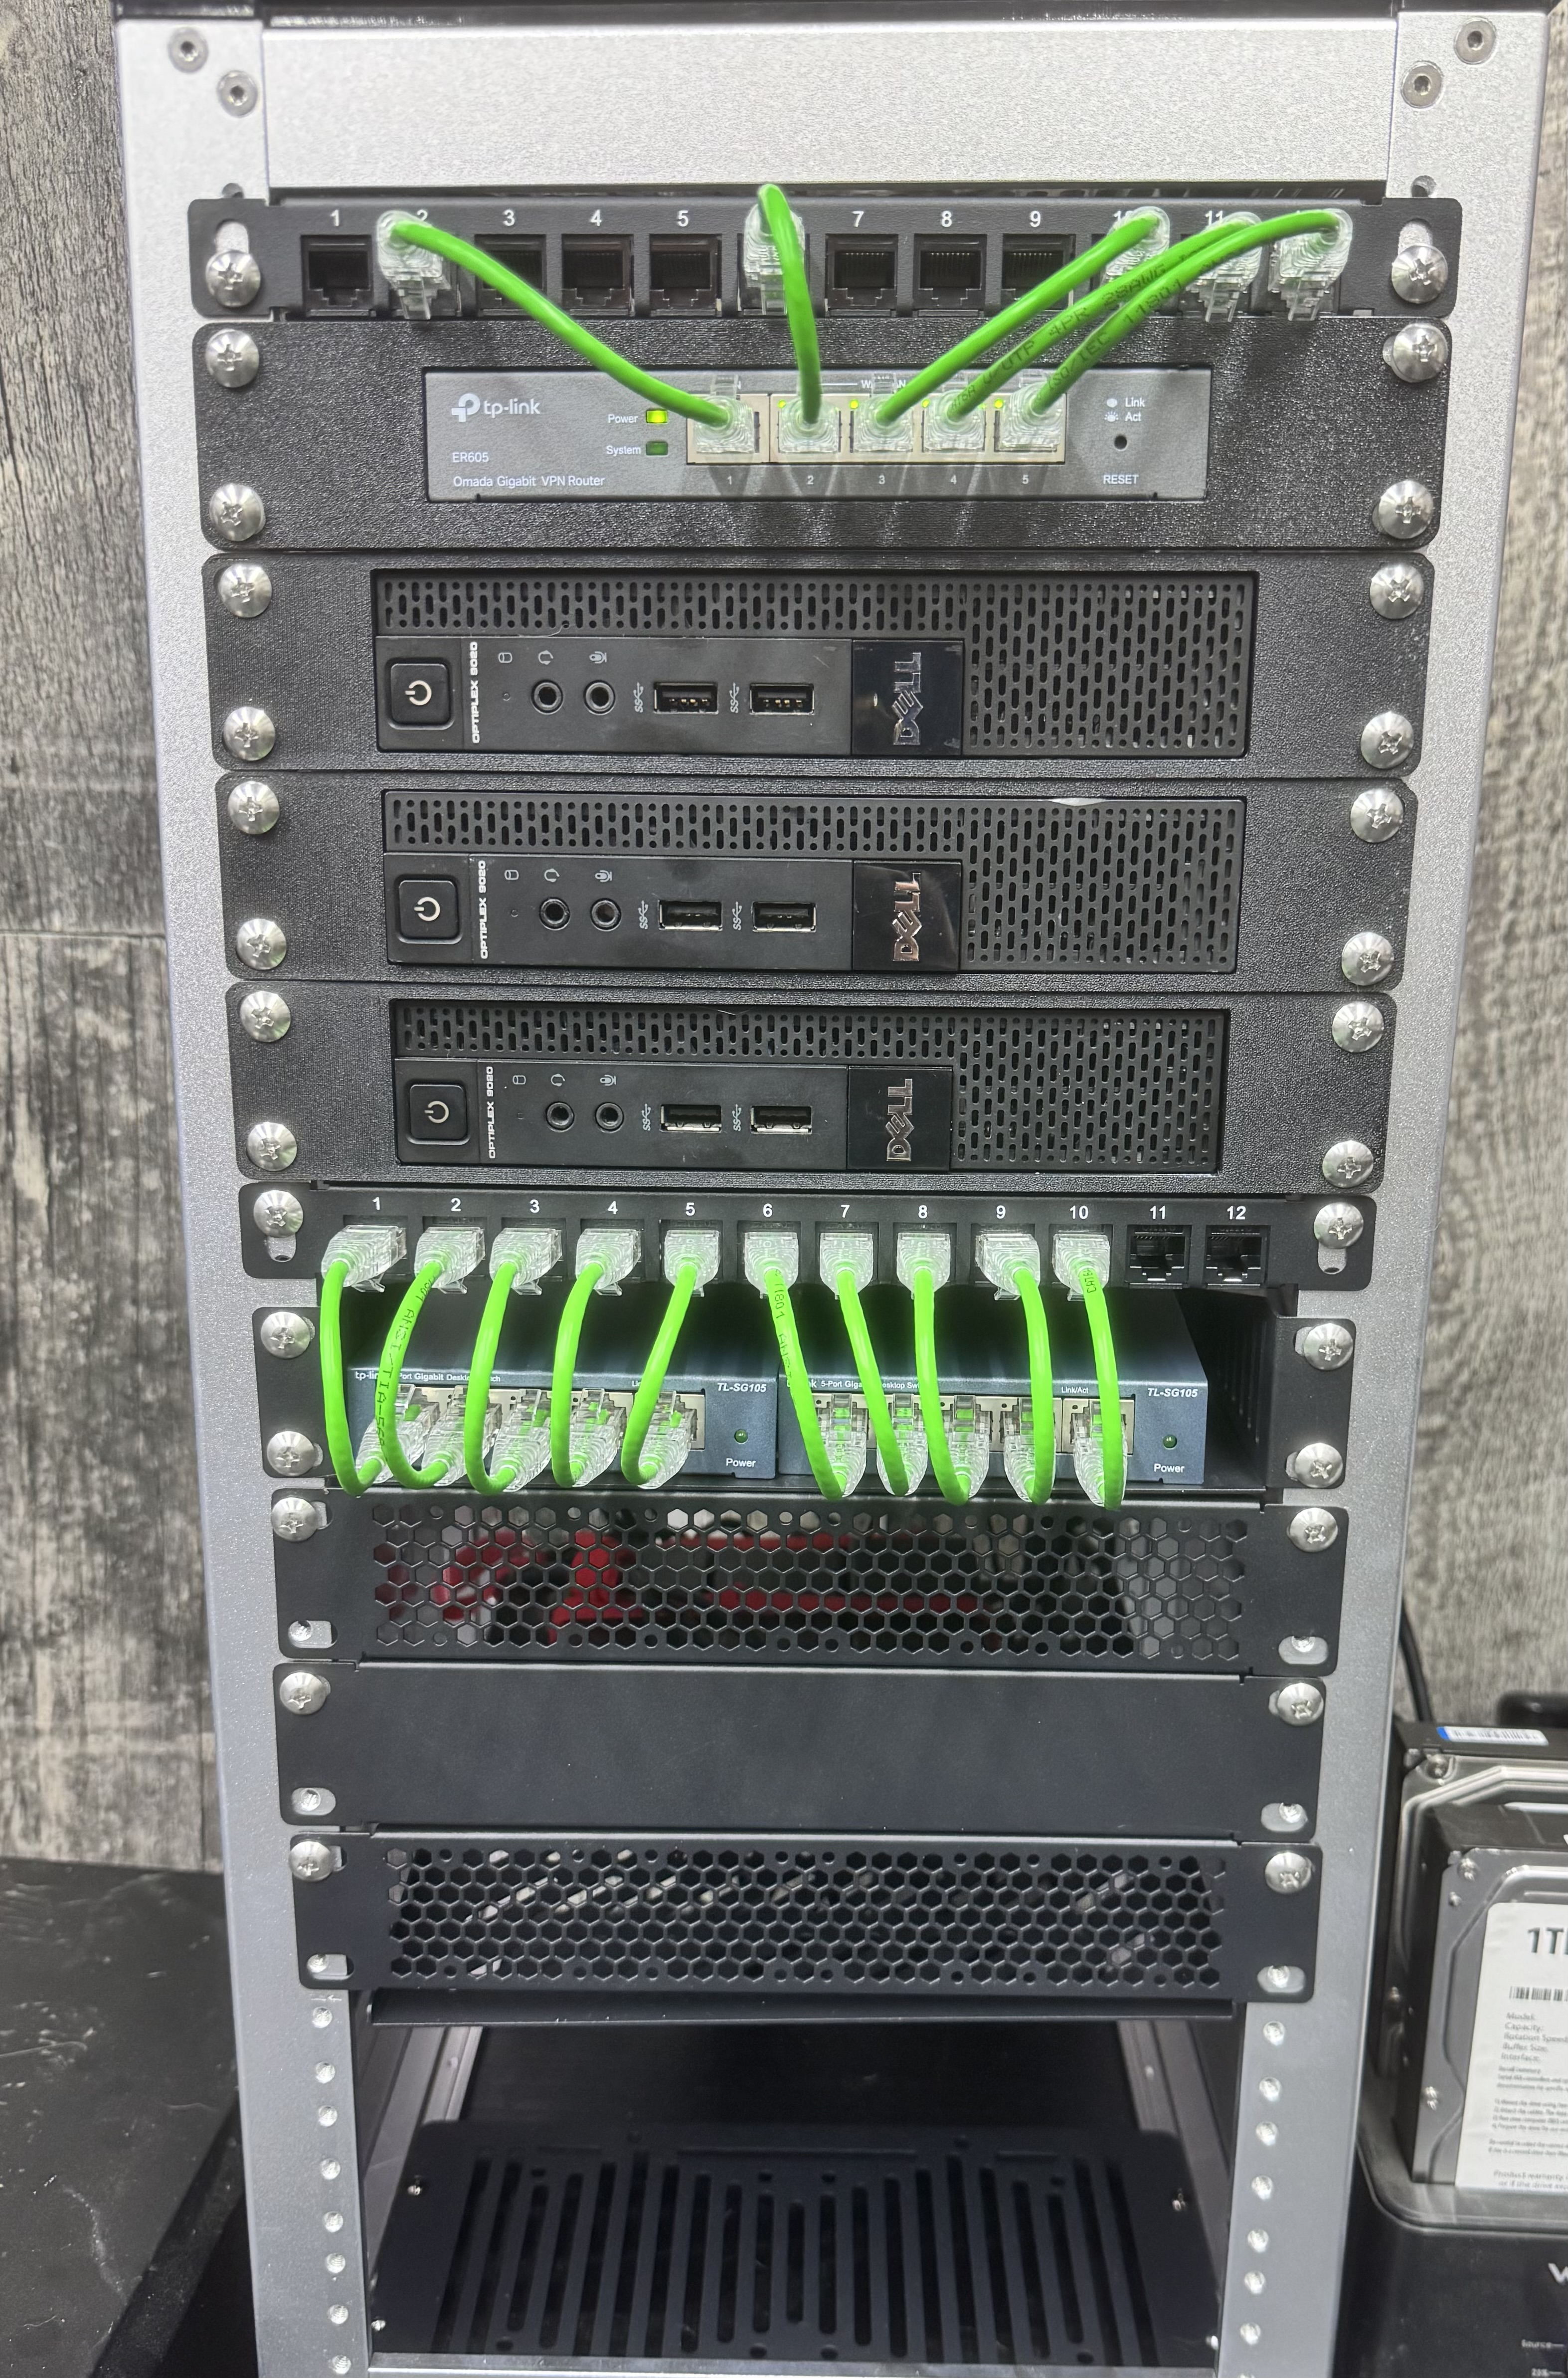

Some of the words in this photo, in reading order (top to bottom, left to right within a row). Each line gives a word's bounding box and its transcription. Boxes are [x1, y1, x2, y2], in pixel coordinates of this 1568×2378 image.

[330, 210, 341, 226] 1
[417, 209, 428, 222] 2
[503, 210, 516, 226] 3
[590, 210, 602, 226] 4
[677, 211, 689, 227] 5
[853, 211, 864, 227] 7
[941, 211, 952, 227] 8
[1030, 211, 1041, 227] 9
[1206, 210, 1223, 226] 11
[483, 399, 540, 418] tp-link
[1125, 397, 1145, 407] Link
[608, 414, 638, 424] Power
[1125, 412, 1141, 422] Act
[452, 452, 489, 463] ER605
[606, 445, 641, 456] System
[453, 476, 493, 487] Omada
[497, 475, 536, 489] Gigabit
[542, 475, 565, 487] VPN
[568, 475, 605, 487] Router
[727, 475, 732, 485] 1
[807, 475, 814, 485] 2
[878, 475, 885, 485] 3
[950, 475, 957, 485] 4
[1022, 475, 1029, 485] 5
[1103, 474, 1139, 485] RESET
[470, 641, 478, 676] 9020
[892, 652, 923, 745] DELL
[470, 680, 480, 743] OPTIPLEX
[478, 860, 487, 894] 9020
[892, 873, 922, 961] DELL
[479, 898, 488, 959] OPTIPLEX
[885, 1079, 914, 1161] DELL
[487, 1101, 496, 1158] OPTIPLEX
[372, 1197, 380, 1211] 1
[450, 1198, 461, 1212] 2
[529, 1199, 540, 1213] 3
[607, 1201, 618, 1214] 4
[686, 1202, 696, 1216] 5
[762, 1203, 773, 1217] 6
[841, 1205, 851, 1218] 7
[918, 1205, 928, 1219] 8
[996, 1205, 1006, 1219] 9
[1069, 1206, 1089, 1220] 10
[1150, 1206, 1166, 1220] 11
[1227, 1206, 1247, 1220] 12
[355, 1370, 378, 1381] tp-lin
[414, 1372, 443, 1382] Gigabit
[717, 1383, 767, 1393] TL-SG105
[845, 1380, 863, 1390] Giga
[882, 1382, 905, 1390] esktop
[1147, 1388, 1198, 1399] TL-SG105
[726, 1458, 756, 1467] Power
[1154, 1463, 1185, 1473] Power
